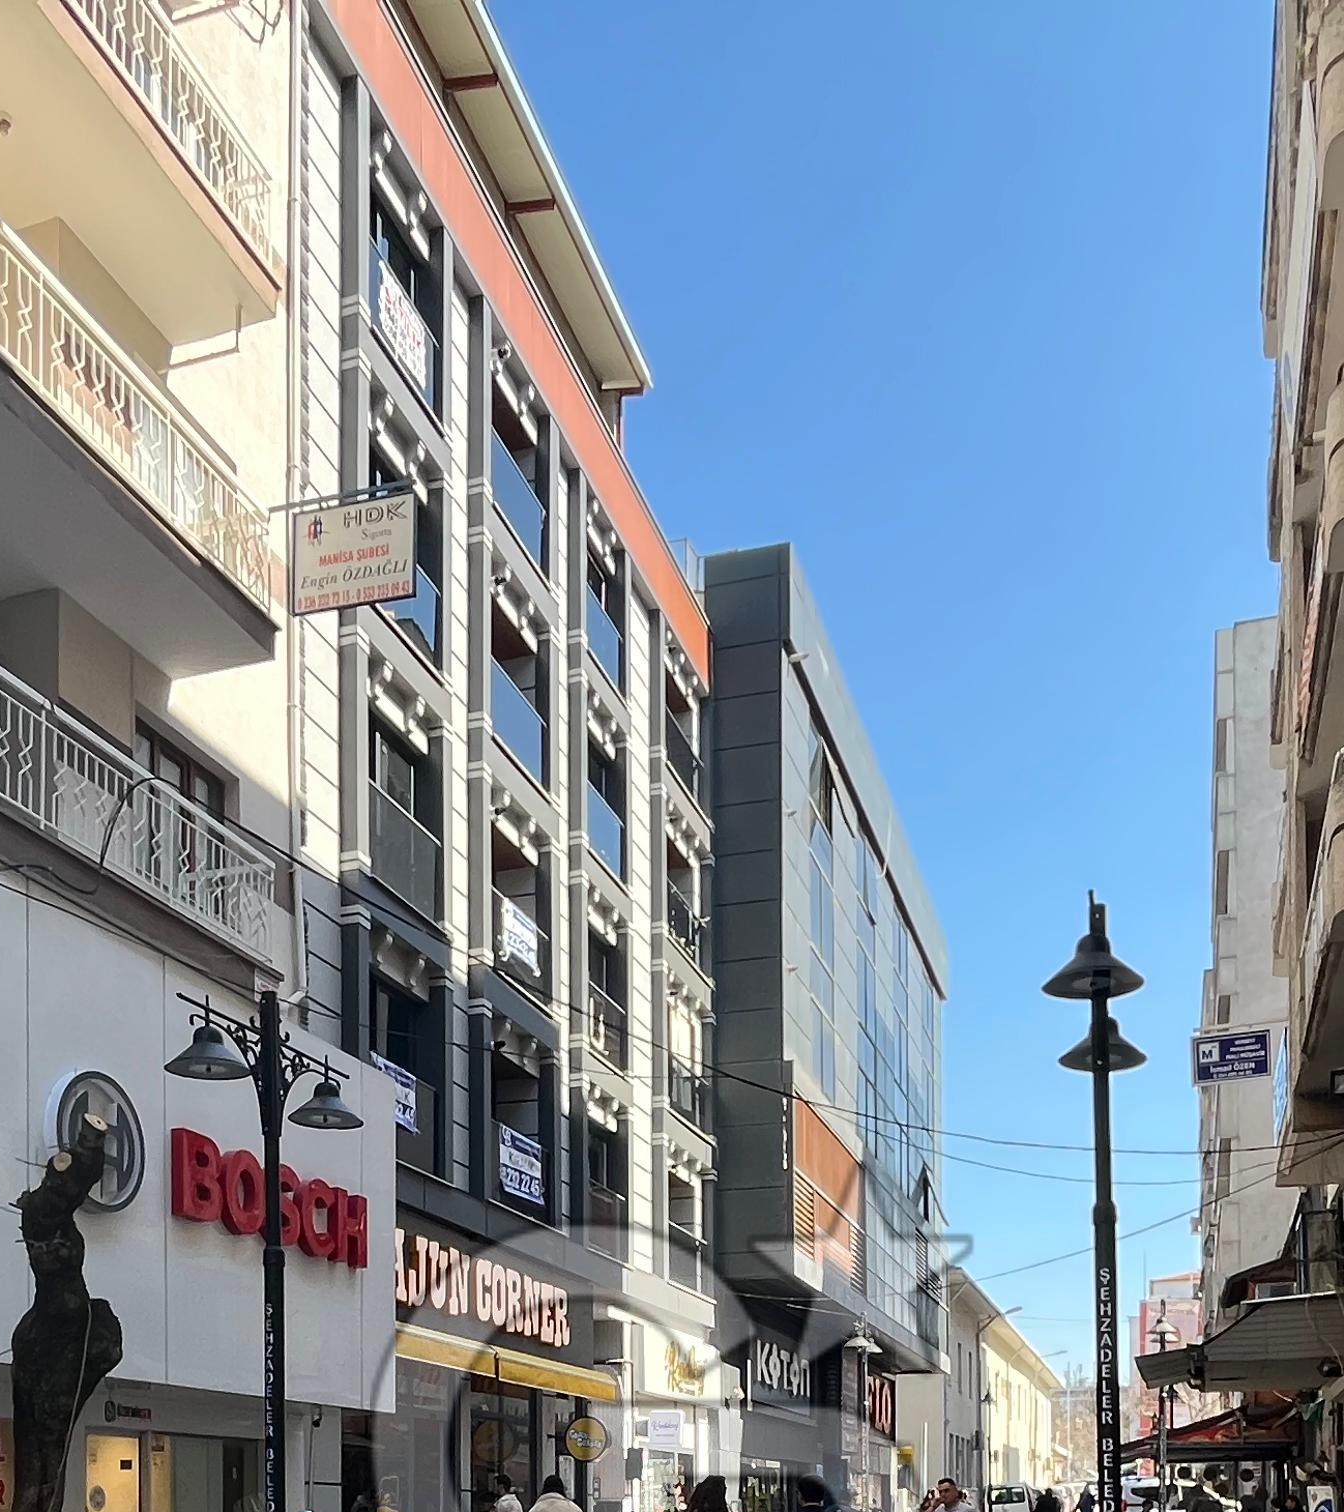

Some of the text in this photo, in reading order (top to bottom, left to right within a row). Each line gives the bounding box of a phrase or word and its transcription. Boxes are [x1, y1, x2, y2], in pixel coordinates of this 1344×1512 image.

[344, 500, 407, 528] HDK
[319, 549, 354, 567] MANİSA
[300, 559, 408, 590] Engin ÖZDAĞLI
[476, 1258, 570, 1347] CORNER
[1099, 1267, 1113, 1425] ŞEHZADELER
